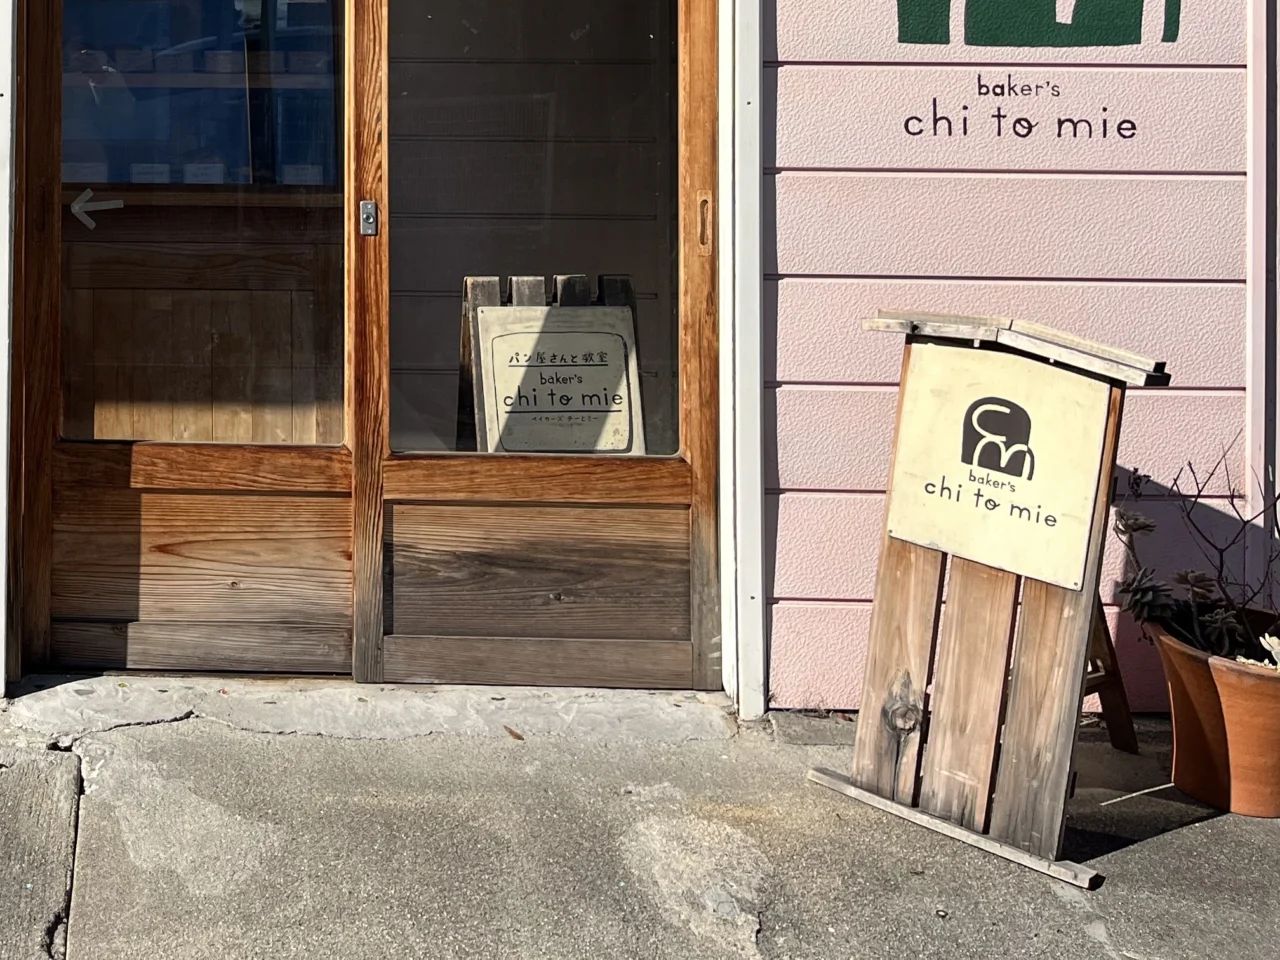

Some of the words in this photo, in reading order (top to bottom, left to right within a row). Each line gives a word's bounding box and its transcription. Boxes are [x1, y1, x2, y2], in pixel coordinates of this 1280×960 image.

[977, 73, 1061, 97] baker's
[904, 97, 969, 137] chi
[991, 106, 1039, 138] to
[1056, 107, 1138, 139] mie
[540, 372, 583, 385] baker's
[503, 385, 538, 407] chi
[547, 388, 573, 407] to
[581, 387, 623, 406] mie
[968, 469, 1017, 493] baker's
[924, 475, 963, 502] chi
[973, 488, 1001, 511] to
[1009, 504, 1058, 528] mie
